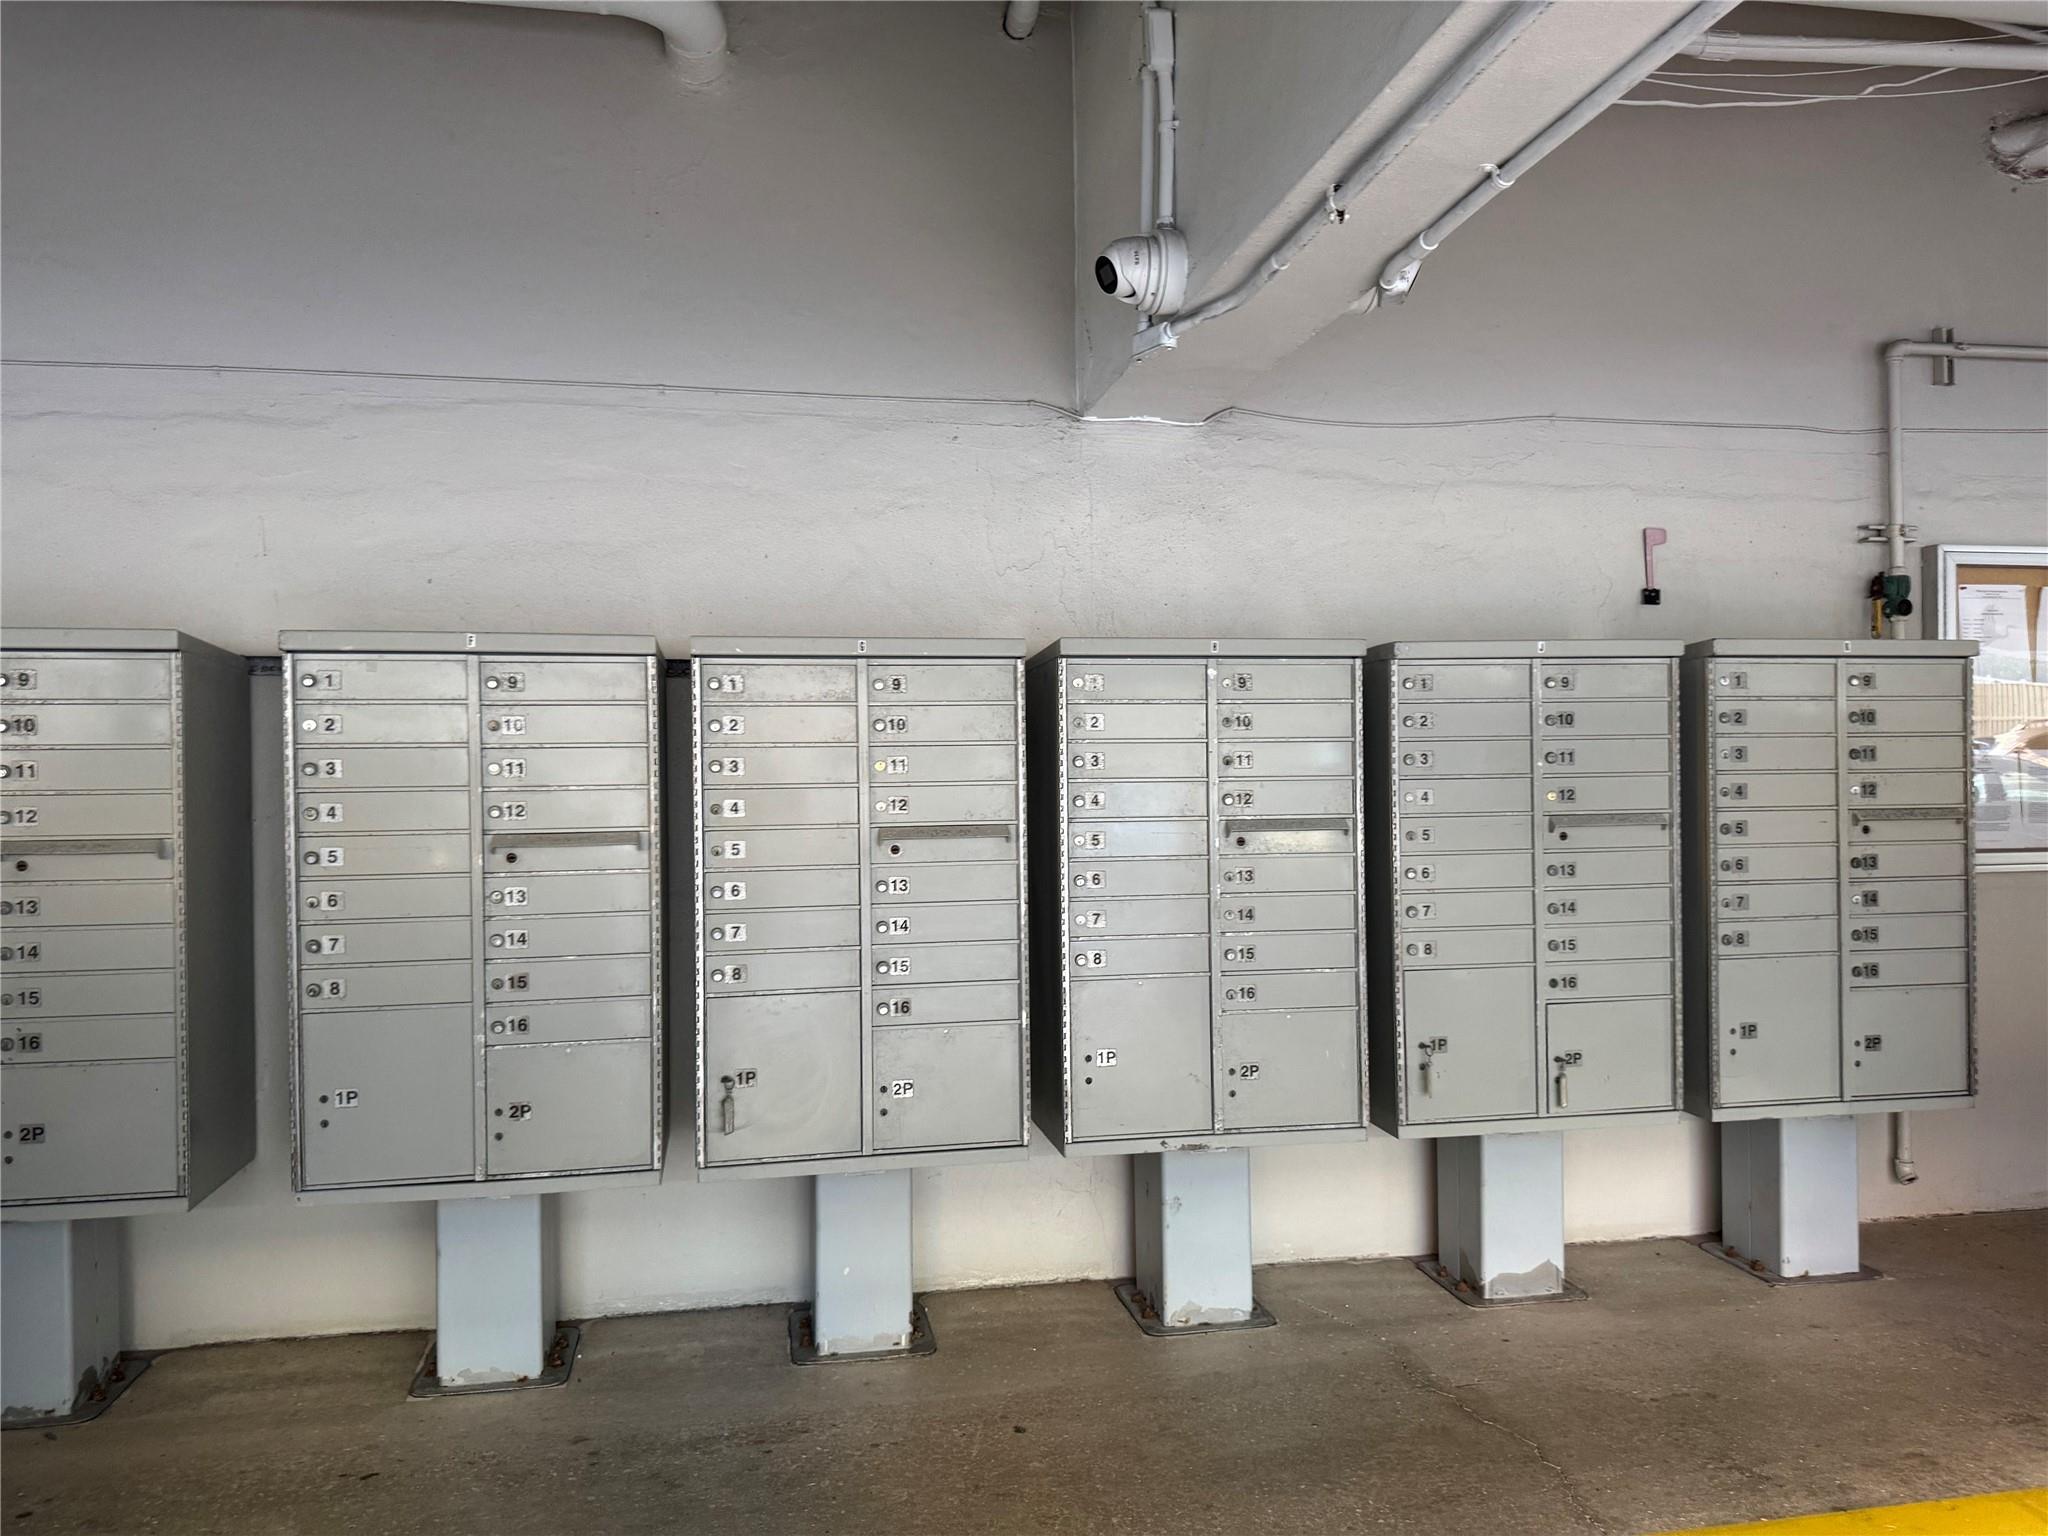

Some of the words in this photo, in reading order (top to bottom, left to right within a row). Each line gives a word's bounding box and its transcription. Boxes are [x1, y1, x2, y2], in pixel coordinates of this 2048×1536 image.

[18, 673, 29, 686] 9
[508, 676, 517, 688] 9
[892, 679, 900, 690] 9
[1238, 677, 1246, 688] 9
[1562, 676, 1569, 688] 9
[1863, 675, 1870, 686] 9
[1090, 716, 1098, 728] 2
[1235, 716, 1250, 727] 10
[1420, 715, 1428, 726] 2
[1558, 713, 1573, 725] 10
[1734, 712, 1742, 723] 2
[1860, 712, 1874, 723] 10
[14, 719, 35, 732] 10
[324, 718, 335, 730] 2
[503, 719, 522, 730] 10
[729, 719, 738, 730] 2
[888, 719, 905, 730] 10
[1421, 753, 1428, 765] 3
[1559, 752, 1573, 763] 11
[1735, 748, 1742, 759] 3
[1862, 749, 1875, 759] 11
[730, 760, 738, 772] 3
[890, 759, 905, 771] 11
[1091, 755, 1099, 767] 3
[1236, 754, 1250, 766] 11
[15, 764, 35, 778] 11
[326, 762, 335, 775] 3
[505, 762, 524, 774] 11
[1559, 789, 1575, 800] 12
[1735, 785, 1743, 796] 4
[1861, 784, 1876, 795] 12
[1090, 795, 1099, 806] 4
[1236, 793, 1252, 805] 12
[1421, 791, 1428, 802] 4
[505, 805, 525, 817] 12
[730, 802, 739, 814] 4
[890, 800, 907, 811] 12
[16, 810, 37, 823] 12
[327, 806, 337, 819] 4
[1736, 823, 1743, 833] 5
[1091, 834, 1100, 846] 5
[1422, 830, 1430, 841] 5
[731, 844, 740, 855] 5
[327, 851, 338, 863] 5
[1862, 857, 1877, 868] 13
[1560, 865, 1575, 876] 13
[1736, 859, 1744, 870] 6
[1092, 873, 1100, 885] 6
[1237, 870, 1253, 881] 13
[1422, 867, 1429, 879] 6
[731, 885, 740, 897] 6
[891, 880, 908, 891] 13
[327, 895, 338, 907] 6
[507, 890, 526, 903] 13
[1736, 896, 1744, 907] 7
[16, 900, 38, 914] 13
[1422, 905, 1430, 917] 7
[1560, 902, 1575, 913] 14
[1091, 913, 1100, 925] 7
[1238, 909, 1253, 921] 14
[892, 920, 908, 931] 14
[731, 926, 741, 938] 7
[1862, 929, 1877, 940] 15
[329, 938, 339, 950] 7
[507, 933, 527, 945] 14
[1736, 933, 1744, 944] 8
[1424, 943, 1432, 955] 8
[1560, 939, 1575, 951] 15
[17, 945, 39, 959] 14
[1238, 948, 1254, 959] 15
[1093, 953, 1102, 965] 8
[892, 960, 909, 972] 15
[1863, 965, 1878, 976] 16
[732, 968, 741, 980] 8
[508, 976, 526, 988] 15
[1561, 977, 1577, 988] 16
[330, 982, 340, 995] 8
[1239, 987, 1255, 999] 16
[18, 991, 39, 1004] 15
[892, 1001, 909, 1013] 16
[508, 1019, 527, 1031] 16
[1741, 1024, 1757, 1036] 1P
[19, 1036, 40, 1049] 16
[1430, 1038, 1447, 1050] 1P
[1865, 1037, 1881, 1048] 2P
[1098, 1052, 1116, 1063] 1P
[1565, 1052, 1582, 1064] 2P
[1241, 1065, 1259, 1077] 2P
[736, 1072, 756, 1085] 1P
[893, 1082, 913, 1095] 2P
[336, 1091, 358, 1104] 1P
[509, 1105, 530, 1118] 2P
[20, 1127, 44, 1141] 2P
